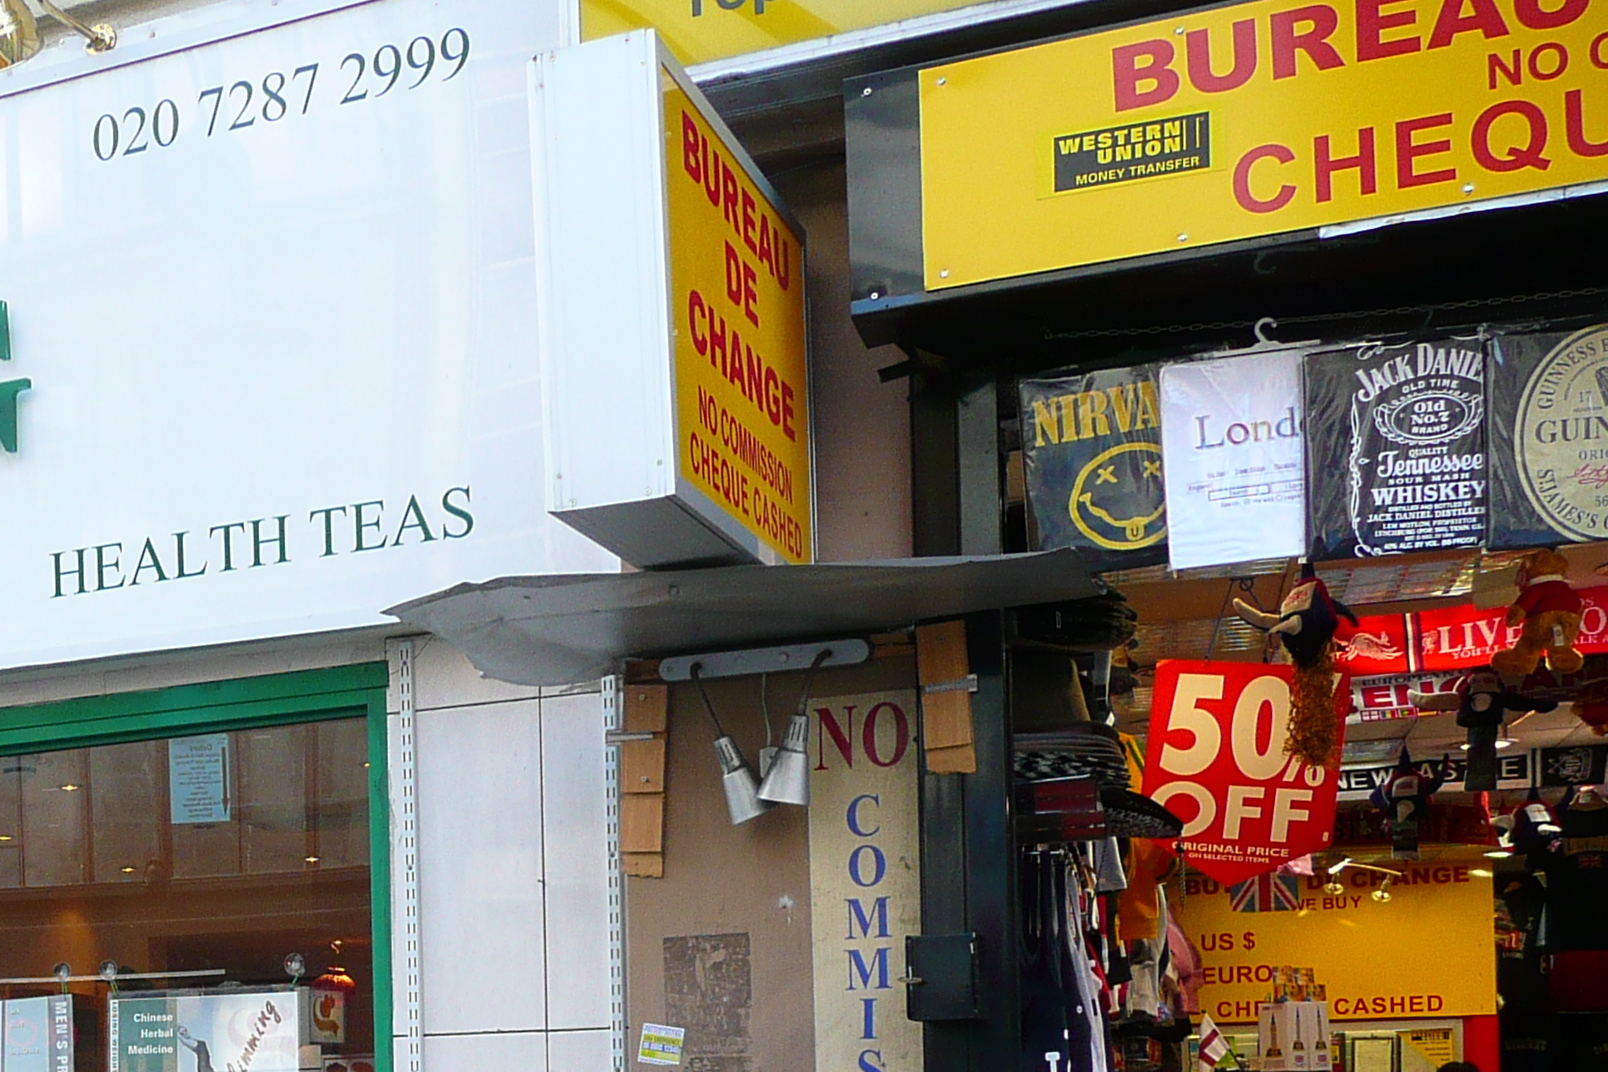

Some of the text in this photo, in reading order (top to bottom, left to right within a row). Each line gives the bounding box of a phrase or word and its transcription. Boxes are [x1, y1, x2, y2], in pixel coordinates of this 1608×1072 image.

[1488, 42, 1569, 90] NO
[92, 27, 471, 161] 020 7287 2999
[1058, 121, 1181, 155] WESTERN
[1097, 137, 1181, 164] UNION
[1075, 156, 1200, 186] MONEY TRANSFER
[682, 109, 789, 292] BUREAU
[725, 240, 759, 329] DE
[688, 289, 796, 442] CHANGE
[1355, 354, 1415, 402] JACK
[1537, 338, 1598, 410] GUINNESS
[1402, 378, 1460, 393] OLD TIME
[1031, 380, 1160, 447] NIRVA
[1413, 400, 1445, 414] Old
[1195, 406, 1303, 450] Lond
[1411, 424, 1448, 434] BRAND
[698, 384, 792, 506] NO COMMISSION
[1408, 447, 1449, 458] QUALITY
[1377, 450, 1483, 478] Tennessee
[690, 432, 802, 560] CHEQUE CASHED
[1370, 480, 1486, 506] WHISKEY
[1366, 511, 1433, 523] JACK DANIEL
[49, 485, 475, 598] HEALTH TEAS
[813, 702, 909, 771] NO
[1149, 781, 1314, 843] OFF
[1247, 845, 1290, 859] PRICE
[1321, 895, 1361, 911] BUY
[1201, 931, 1256, 952] US $
[1202, 965, 1273, 984] EURO
[133, 1013, 173, 1023] Chinese
[1334, 995, 1444, 1016] CASHED
[55, 1001, 69, 1050] MEN'S
[140, 1029, 173, 1038] Herbal
[128, 1045, 173, 1055] Medicine
